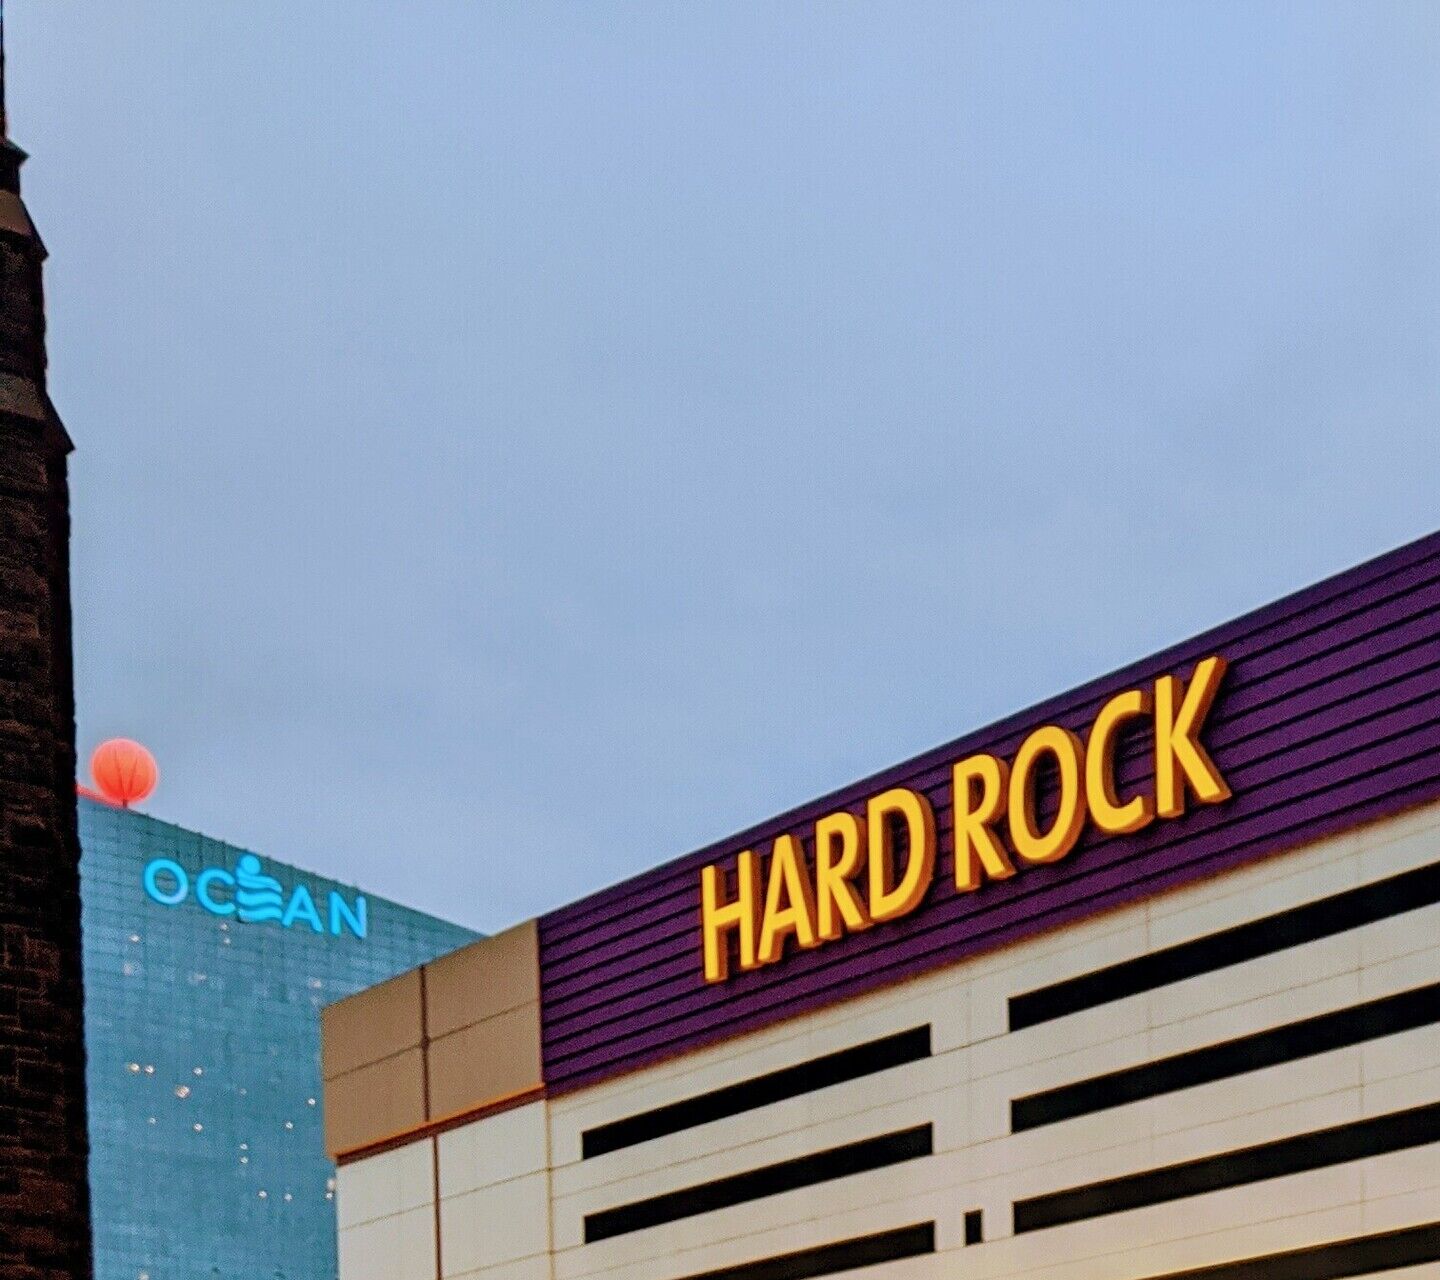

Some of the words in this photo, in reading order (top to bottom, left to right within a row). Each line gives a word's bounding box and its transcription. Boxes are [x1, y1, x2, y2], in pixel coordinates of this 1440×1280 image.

[143, 854, 367, 940] OCEAN
[701, 787, 936, 983] HARD
[952, 655, 1231, 891] ROCK
